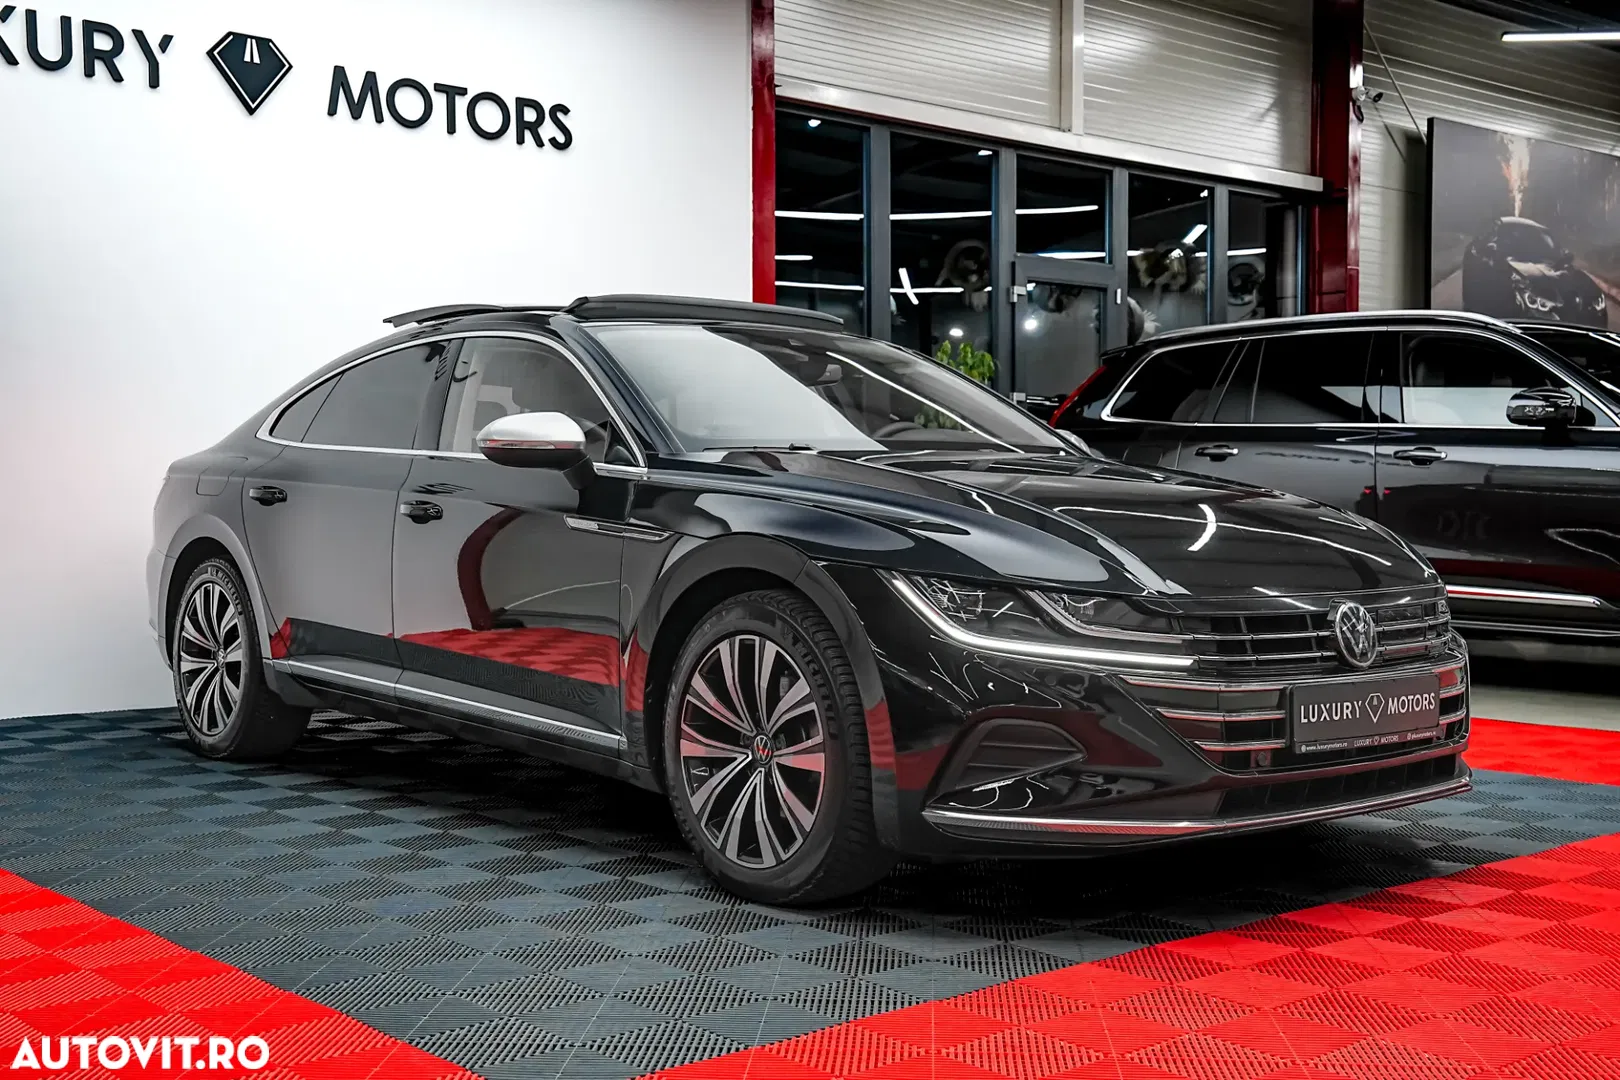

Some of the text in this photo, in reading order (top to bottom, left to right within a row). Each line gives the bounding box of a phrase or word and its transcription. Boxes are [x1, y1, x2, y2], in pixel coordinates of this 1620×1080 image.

[327, 65, 574, 151] MOTORS
[1301, 692, 1436, 723] LUXURY MOTORS
[1354, 735, 1399, 747] LUXURY MOTORS
